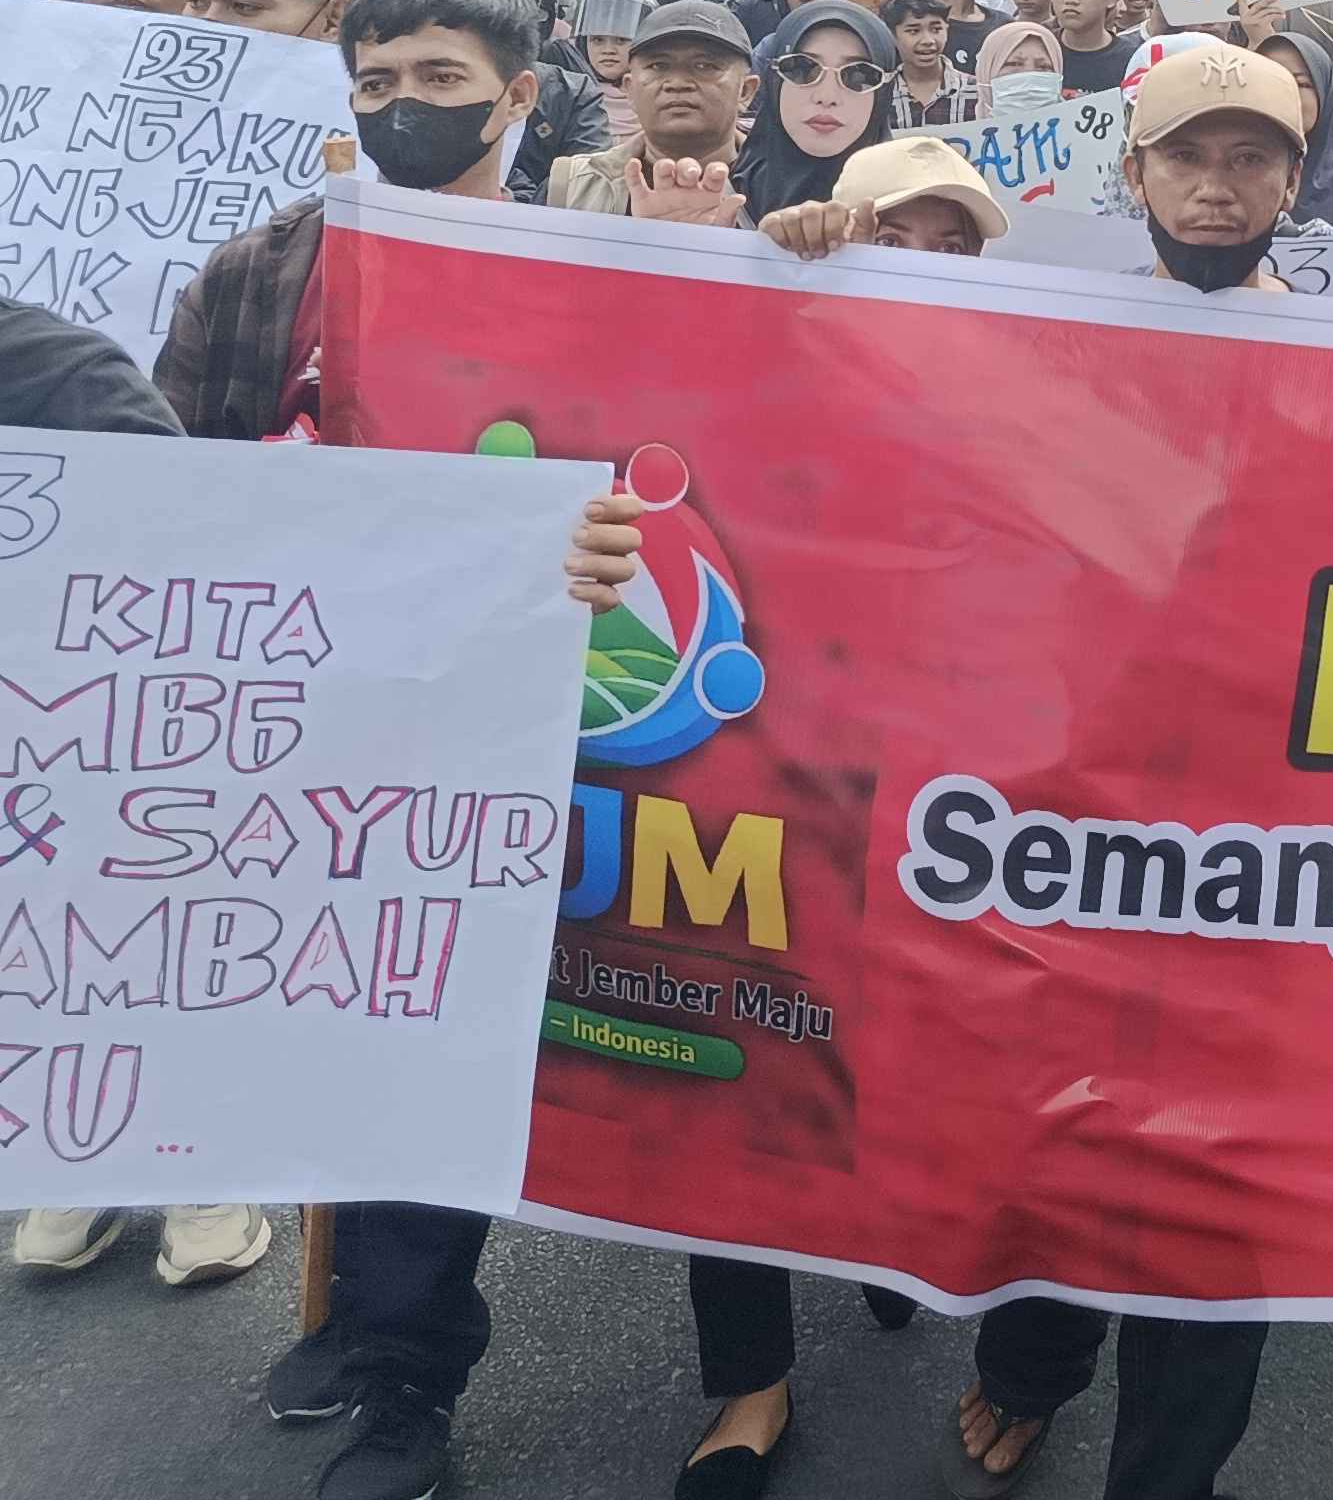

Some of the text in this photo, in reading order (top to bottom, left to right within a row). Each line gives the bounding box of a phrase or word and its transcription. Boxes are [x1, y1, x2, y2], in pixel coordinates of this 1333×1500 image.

[135, 28, 228, 92] 93
[1074, 104, 1114, 140] 98
[55, 573, 333, 668] KITA
[98, 784, 559, 888] SAYUR
[577, 950, 723, 1015] Jember
[733, 979, 833, 1041] Maju
[573, 1015, 696, 1064] Indonesia
